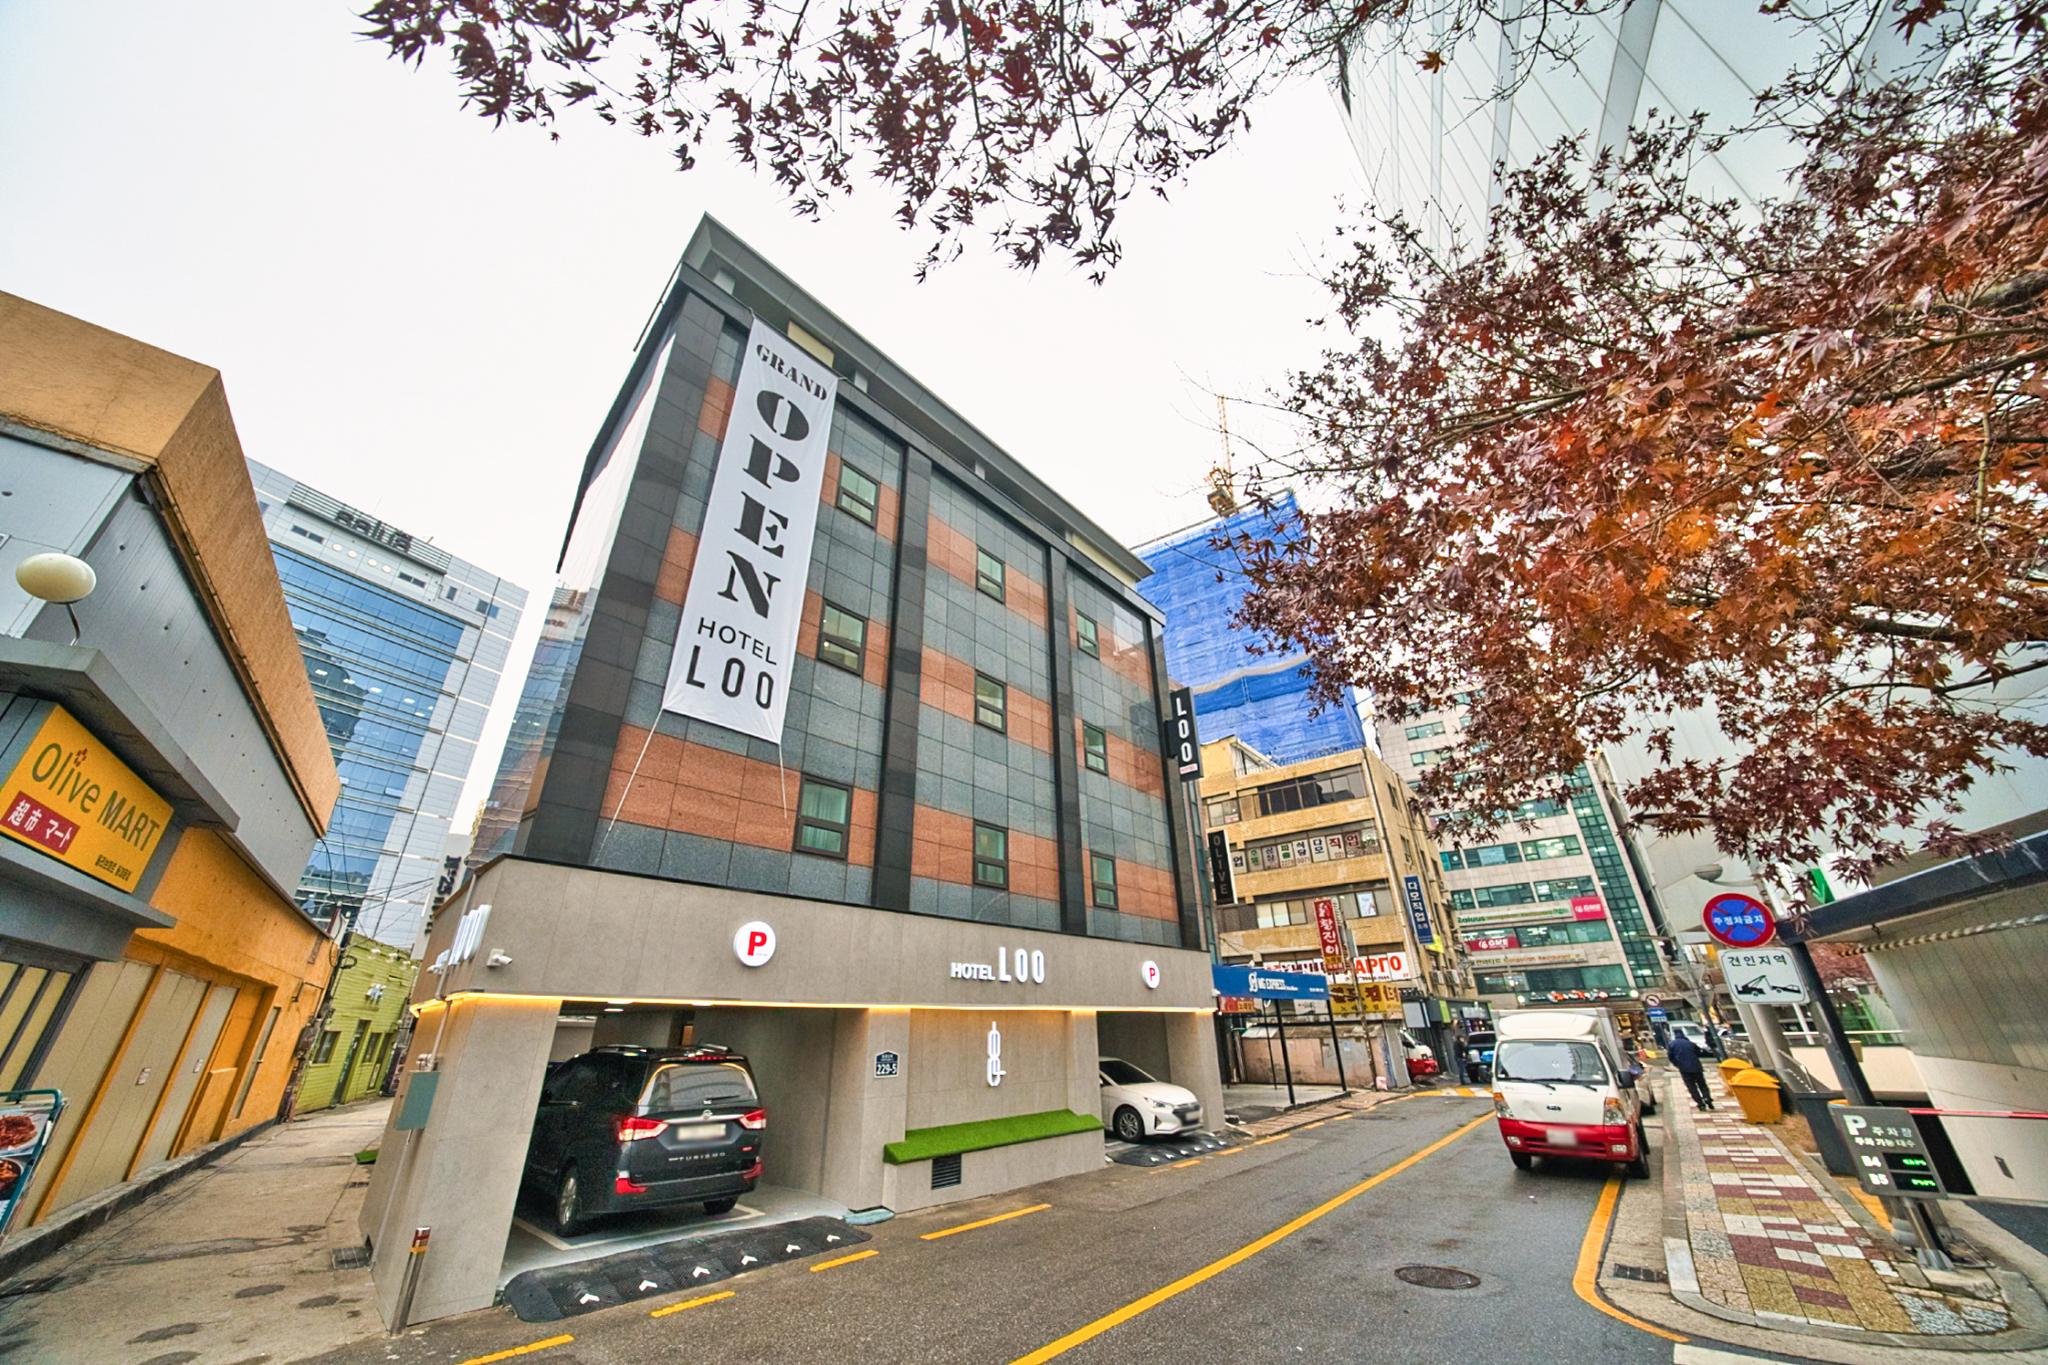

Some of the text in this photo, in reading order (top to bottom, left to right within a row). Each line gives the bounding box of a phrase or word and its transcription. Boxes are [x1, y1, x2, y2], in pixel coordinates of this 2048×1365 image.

[756, 343, 828, 401] GRAND
[717, 389, 810, 619] OPEN
[697, 617, 777, 666] HOTEL
[686, 644, 774, 710] LOO
[1176, 697, 1192, 762] LOO
[32, 742, 160, 852] Olive MART
[8, 799, 42, 832] 超市
[45, 819, 73, 848] マート
[1213, 835, 1228, 895] OLIVE
[1713, 914, 1764, 926] 주정차금지
[747, 931, 767, 956] P
[950, 946, 1045, 984] HOTEL LOO
[1149, 967, 1156, 981] P
[1350, 955, 1402, 976] АРГО
[1728, 954, 1787, 967] 견인지역
[877, 1063, 897, 1075] 229-5
[1843, 1114, 1867, 1135] P
